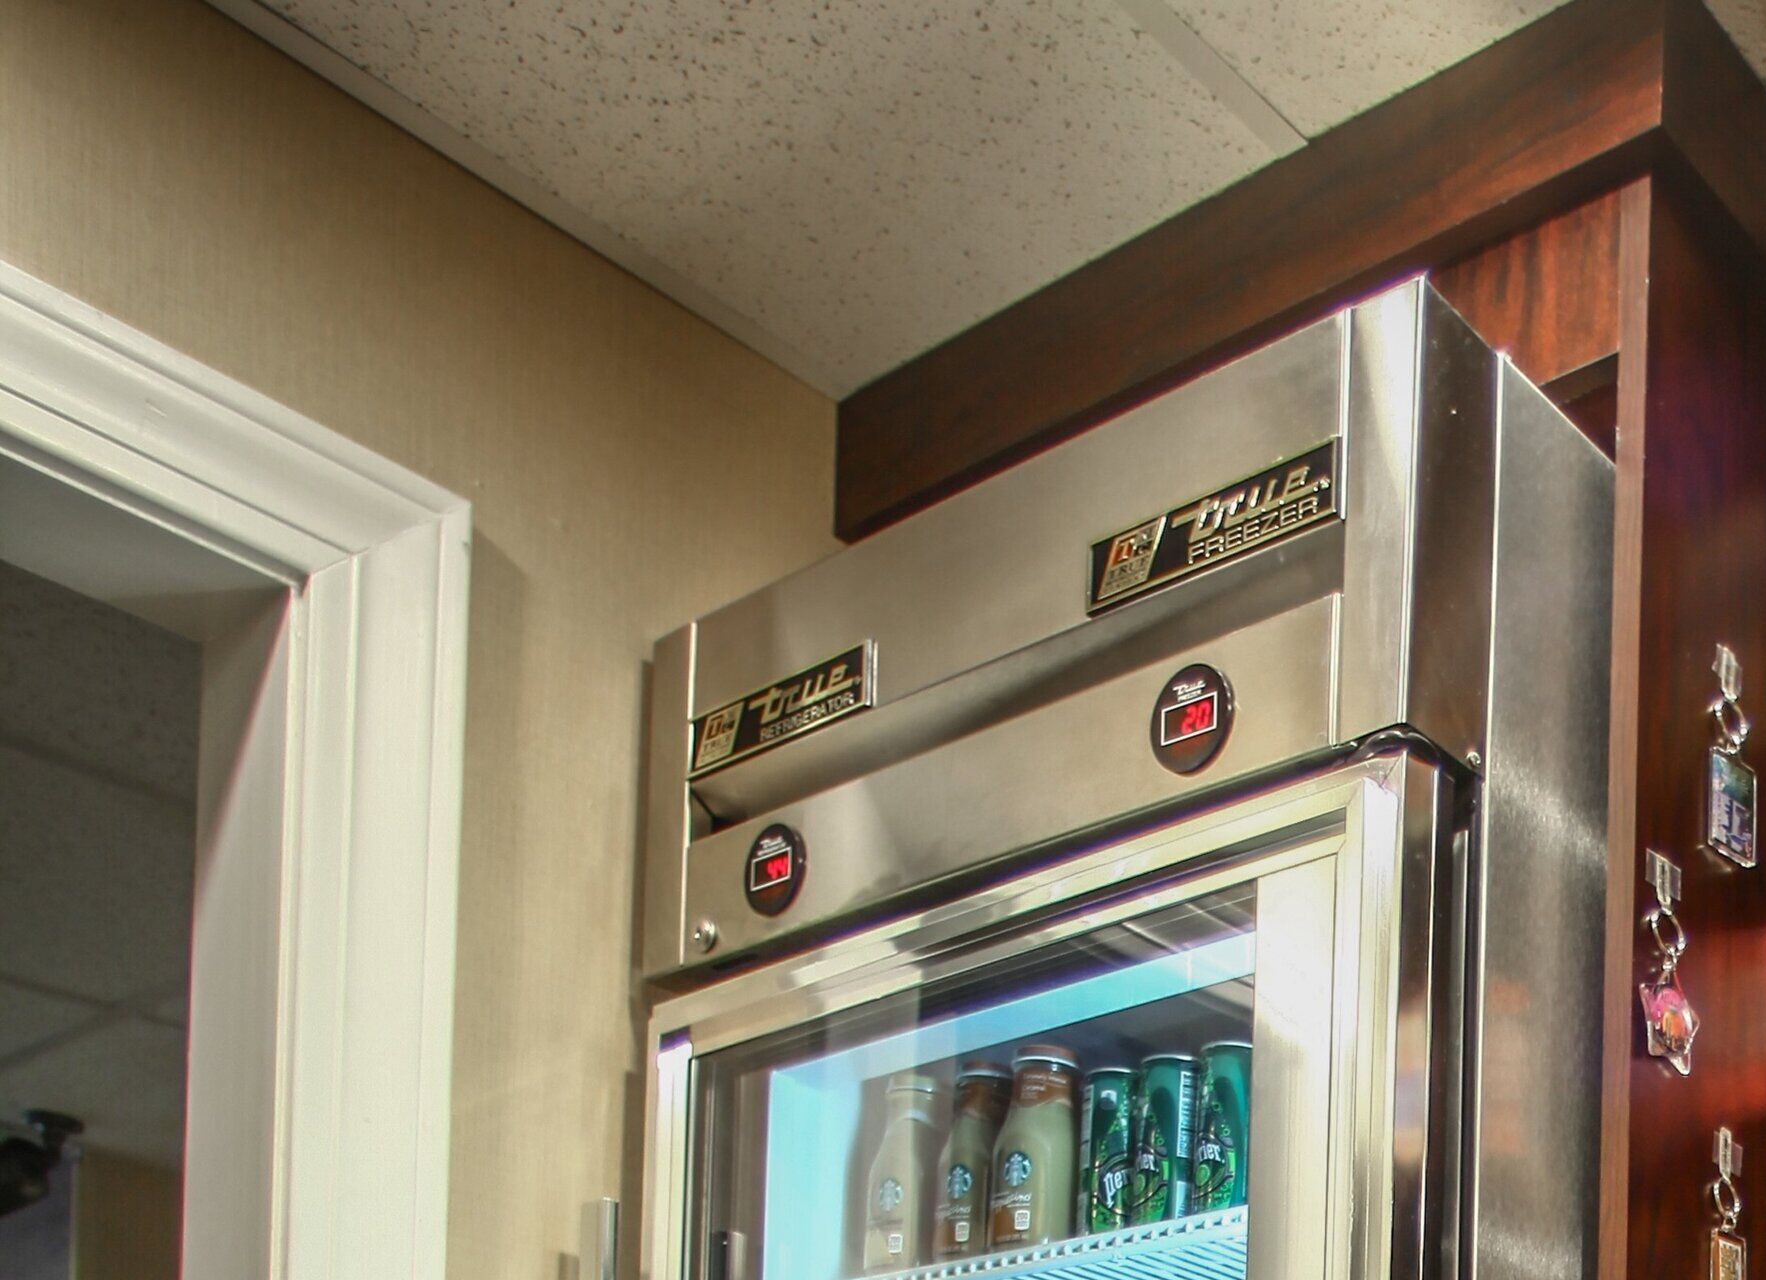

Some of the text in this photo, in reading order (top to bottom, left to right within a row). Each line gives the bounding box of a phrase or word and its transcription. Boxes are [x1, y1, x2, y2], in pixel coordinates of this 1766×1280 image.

[1188, 496, 1319, 565] FREEZER
[760, 693, 854, 741] REFRIGERATOR
[1181, 700, 1212, 734] 20
